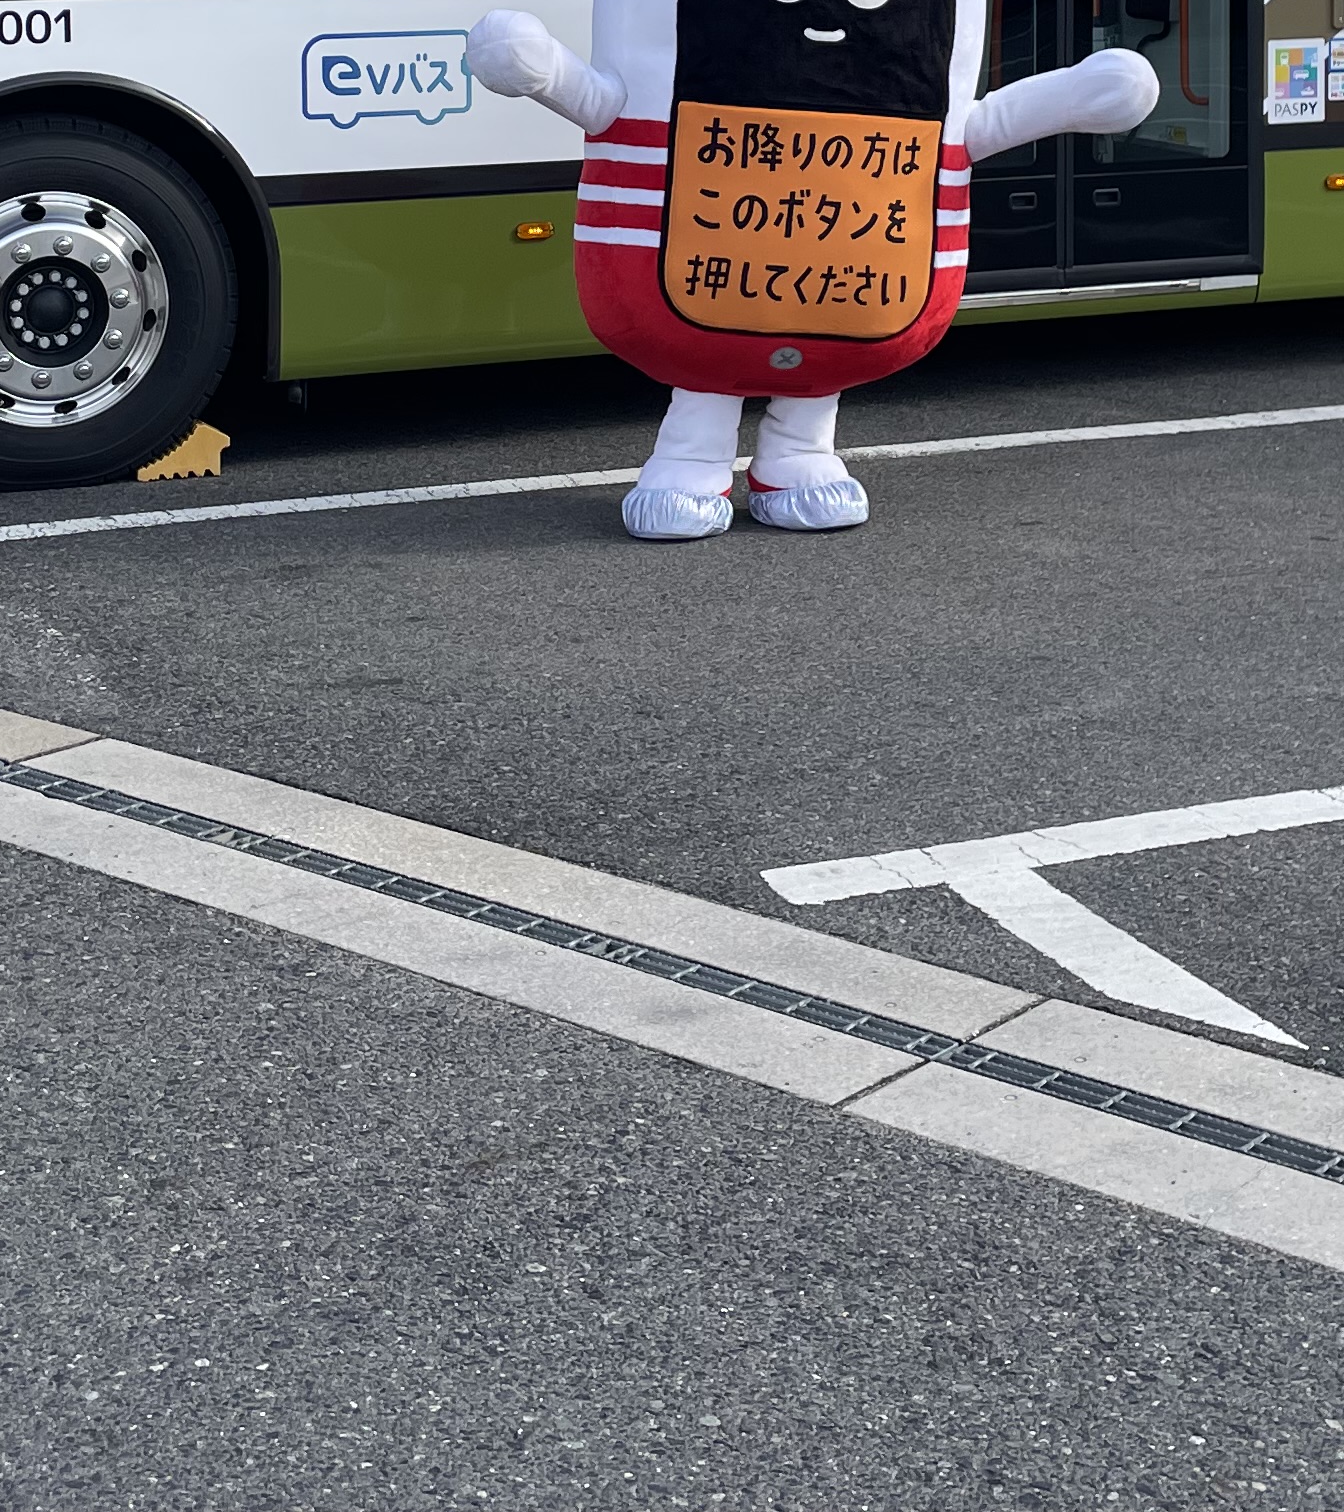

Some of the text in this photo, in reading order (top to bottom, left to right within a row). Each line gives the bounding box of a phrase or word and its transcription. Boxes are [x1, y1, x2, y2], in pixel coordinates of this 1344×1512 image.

[1274, 100, 1318, 118] PASPY
[697, 117, 921, 178] お降りの方は
[693, 189, 906, 244] このボタンを
[685, 254, 907, 306] 押してください
